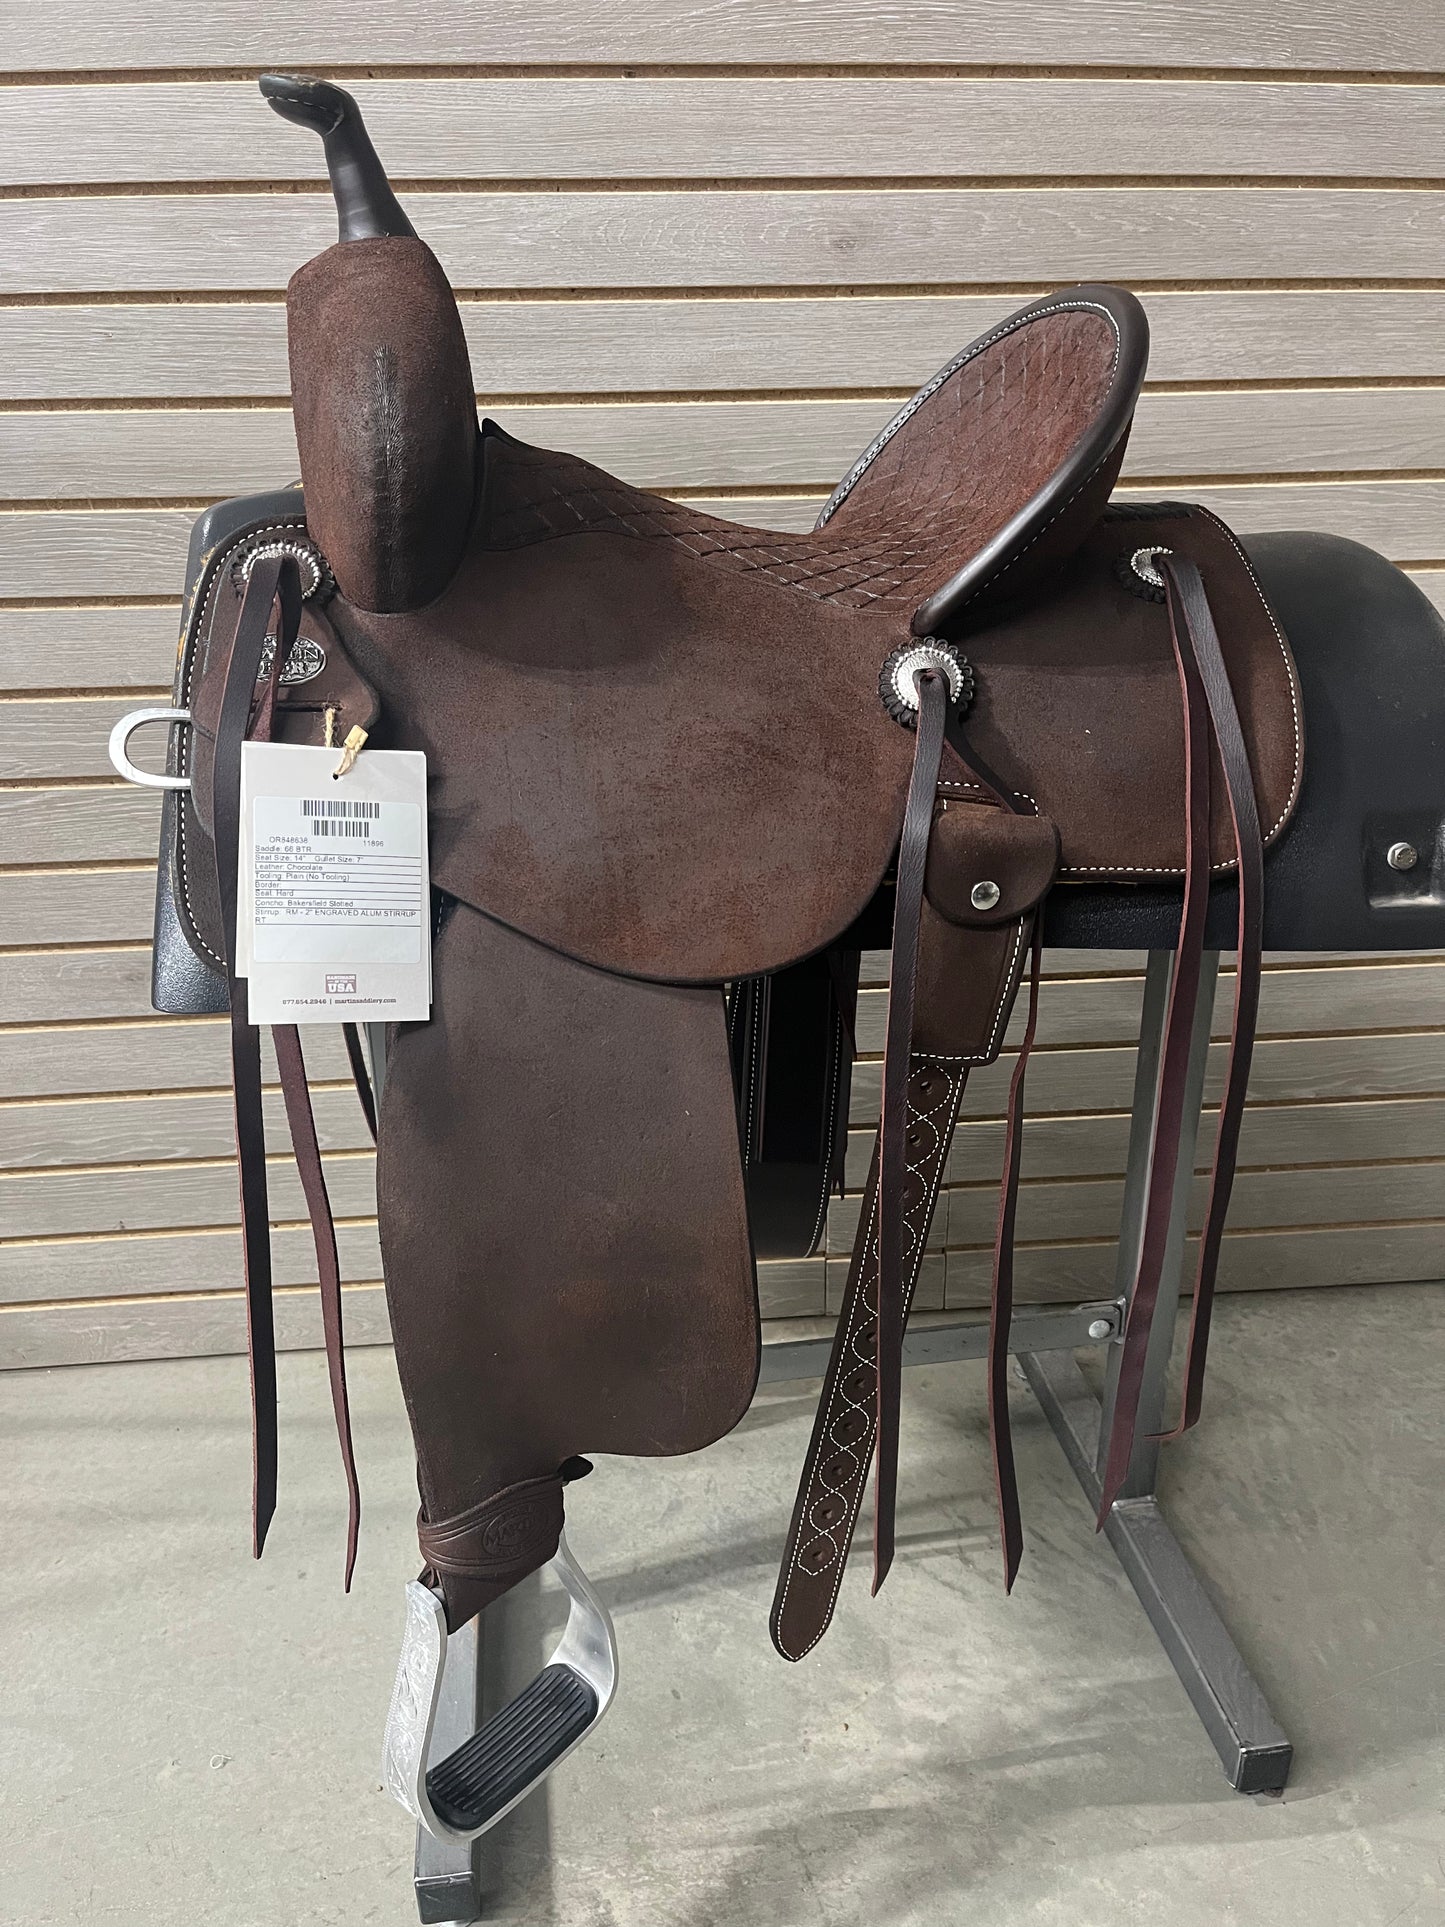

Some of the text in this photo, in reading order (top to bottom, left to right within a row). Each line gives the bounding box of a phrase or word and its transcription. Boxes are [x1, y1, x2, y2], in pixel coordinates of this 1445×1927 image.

[286, 863, 323, 871] Chocolate
[306, 872, 320, 881] (No
[321, 873, 350, 882] Tooling)
[327, 983, 355, 993] USA
